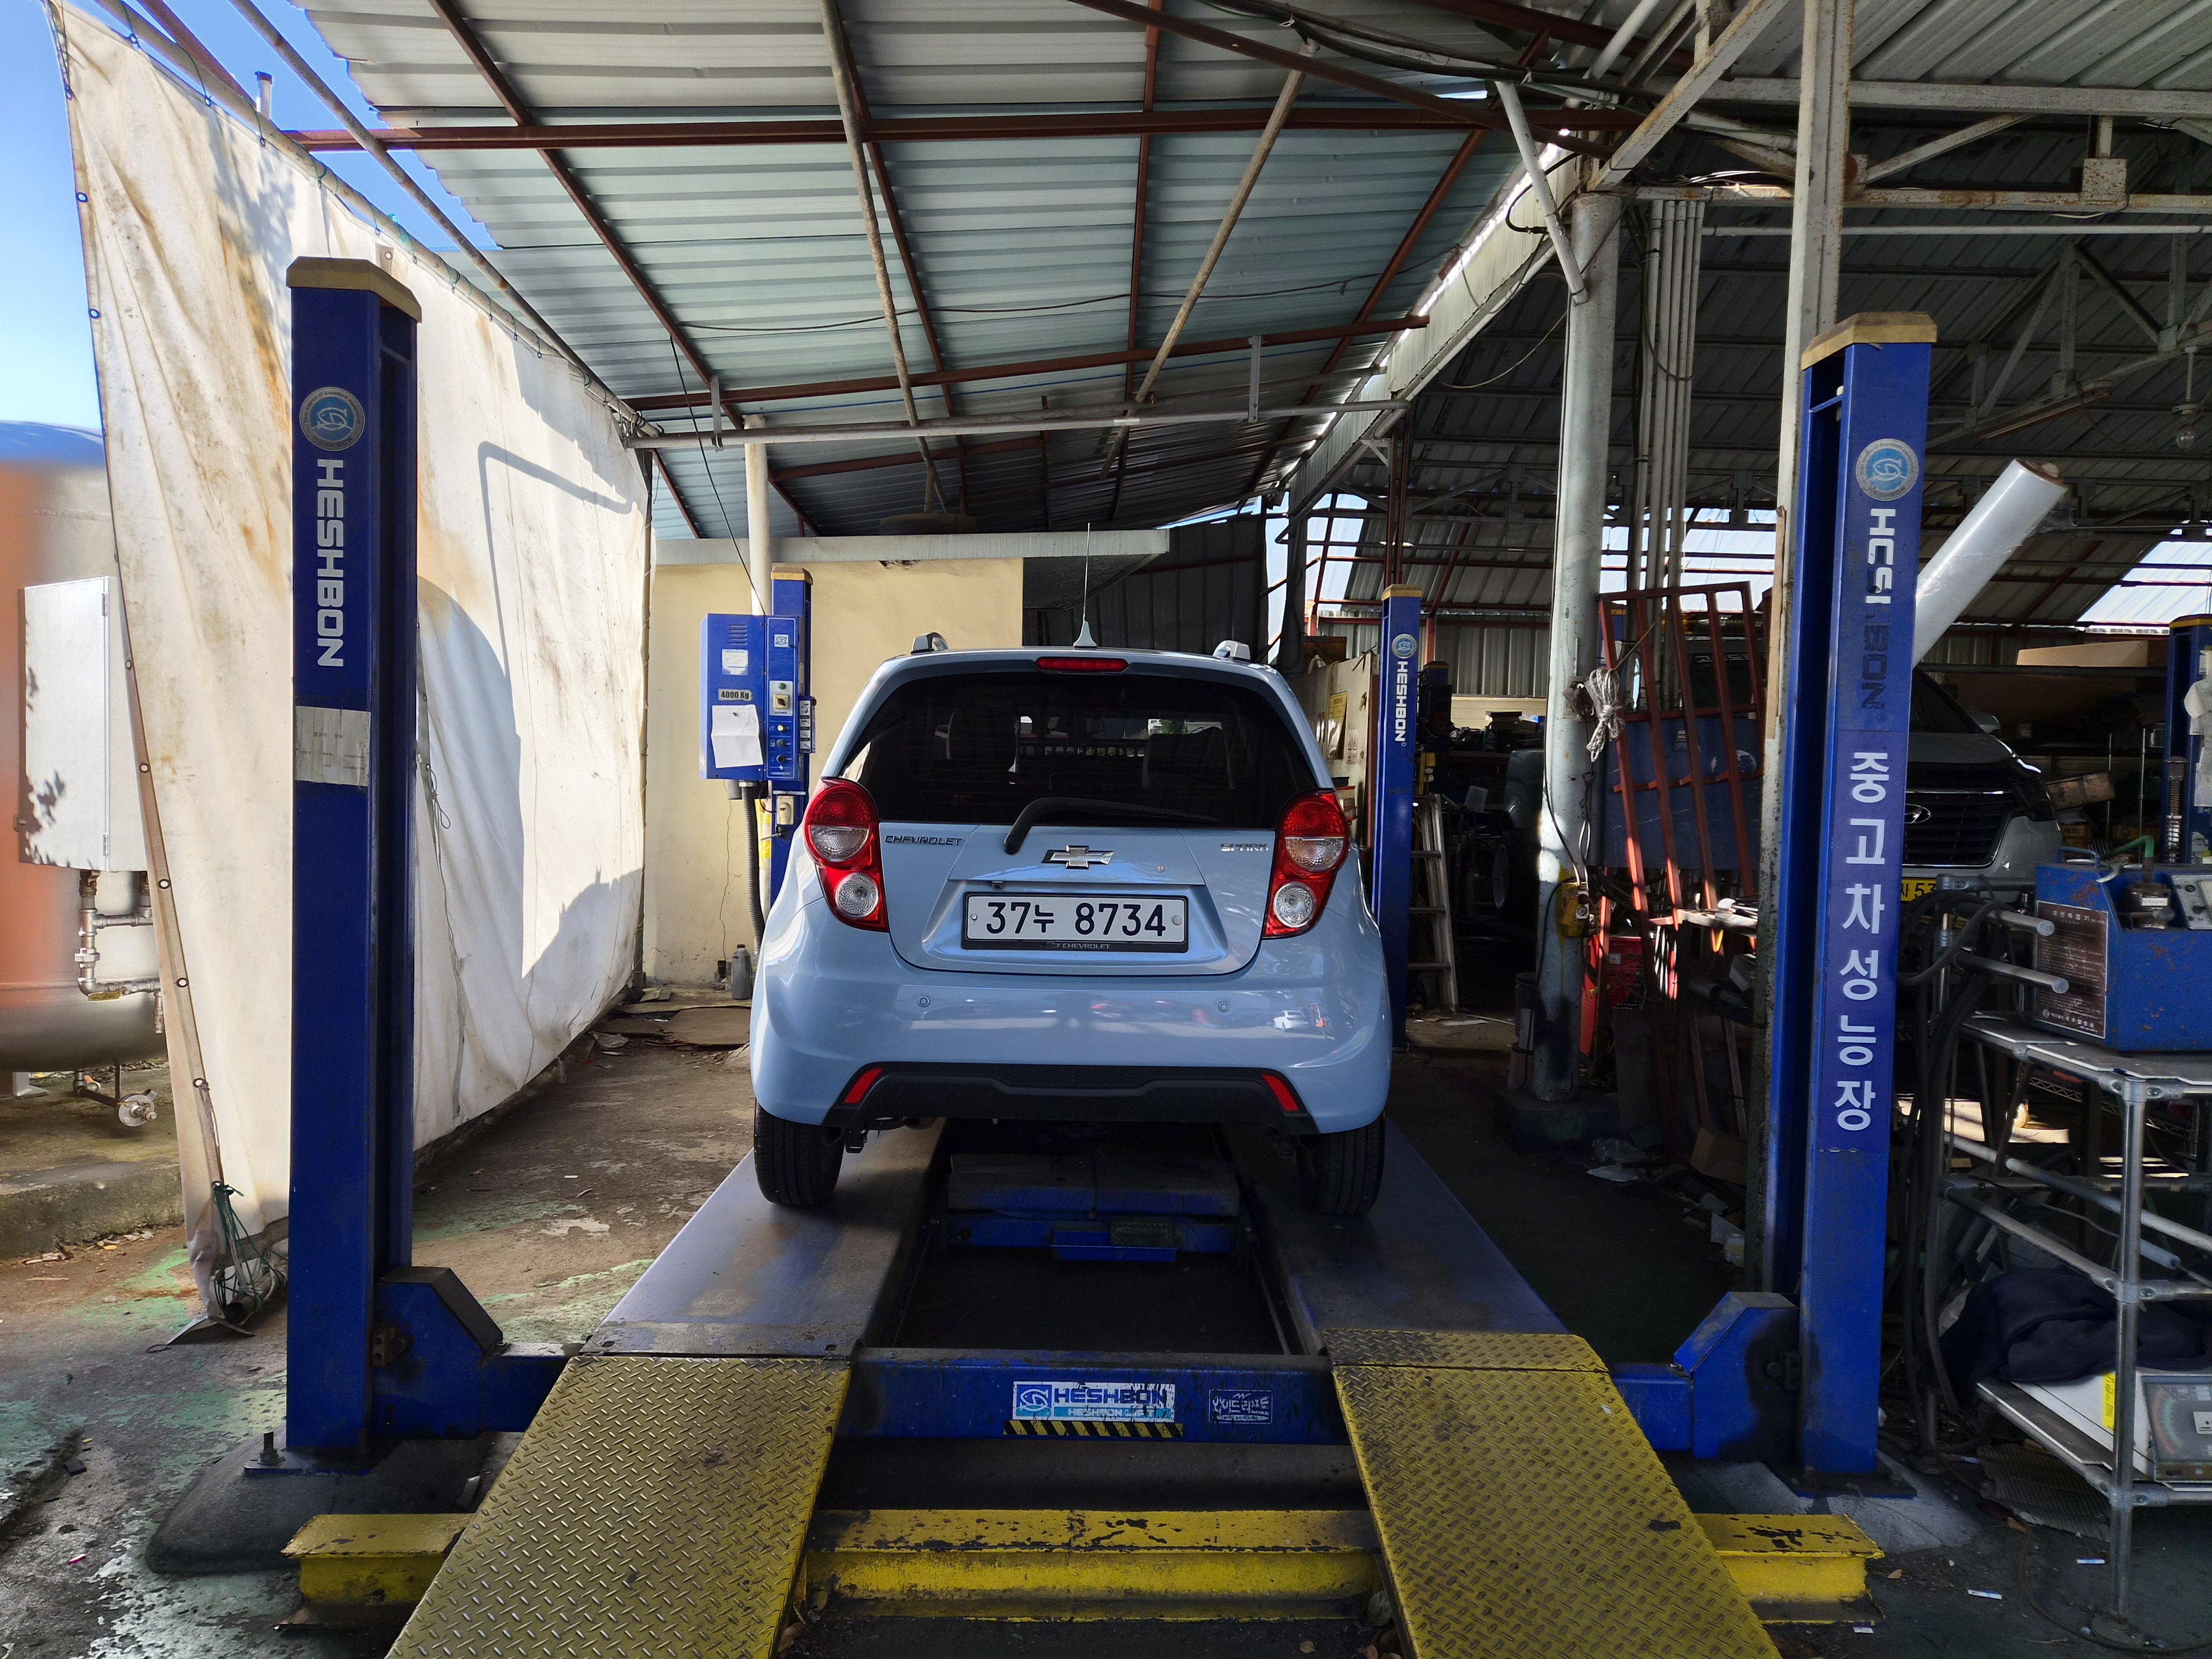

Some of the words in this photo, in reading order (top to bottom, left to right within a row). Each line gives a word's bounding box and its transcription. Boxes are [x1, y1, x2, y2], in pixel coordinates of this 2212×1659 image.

[317, 459, 343, 667] HESHBON
[740, 691, 749, 700] Kg
[1395, 661, 1408, 742] HESHBON
[885, 835, 963, 847] CHEVROLET
[1220, 842, 1269, 853] SPARK
[986, 901, 1055, 935] 37누
[1074, 902, 1166, 937] 8734
[1054, 1388, 1167, 1405] HESHBON
